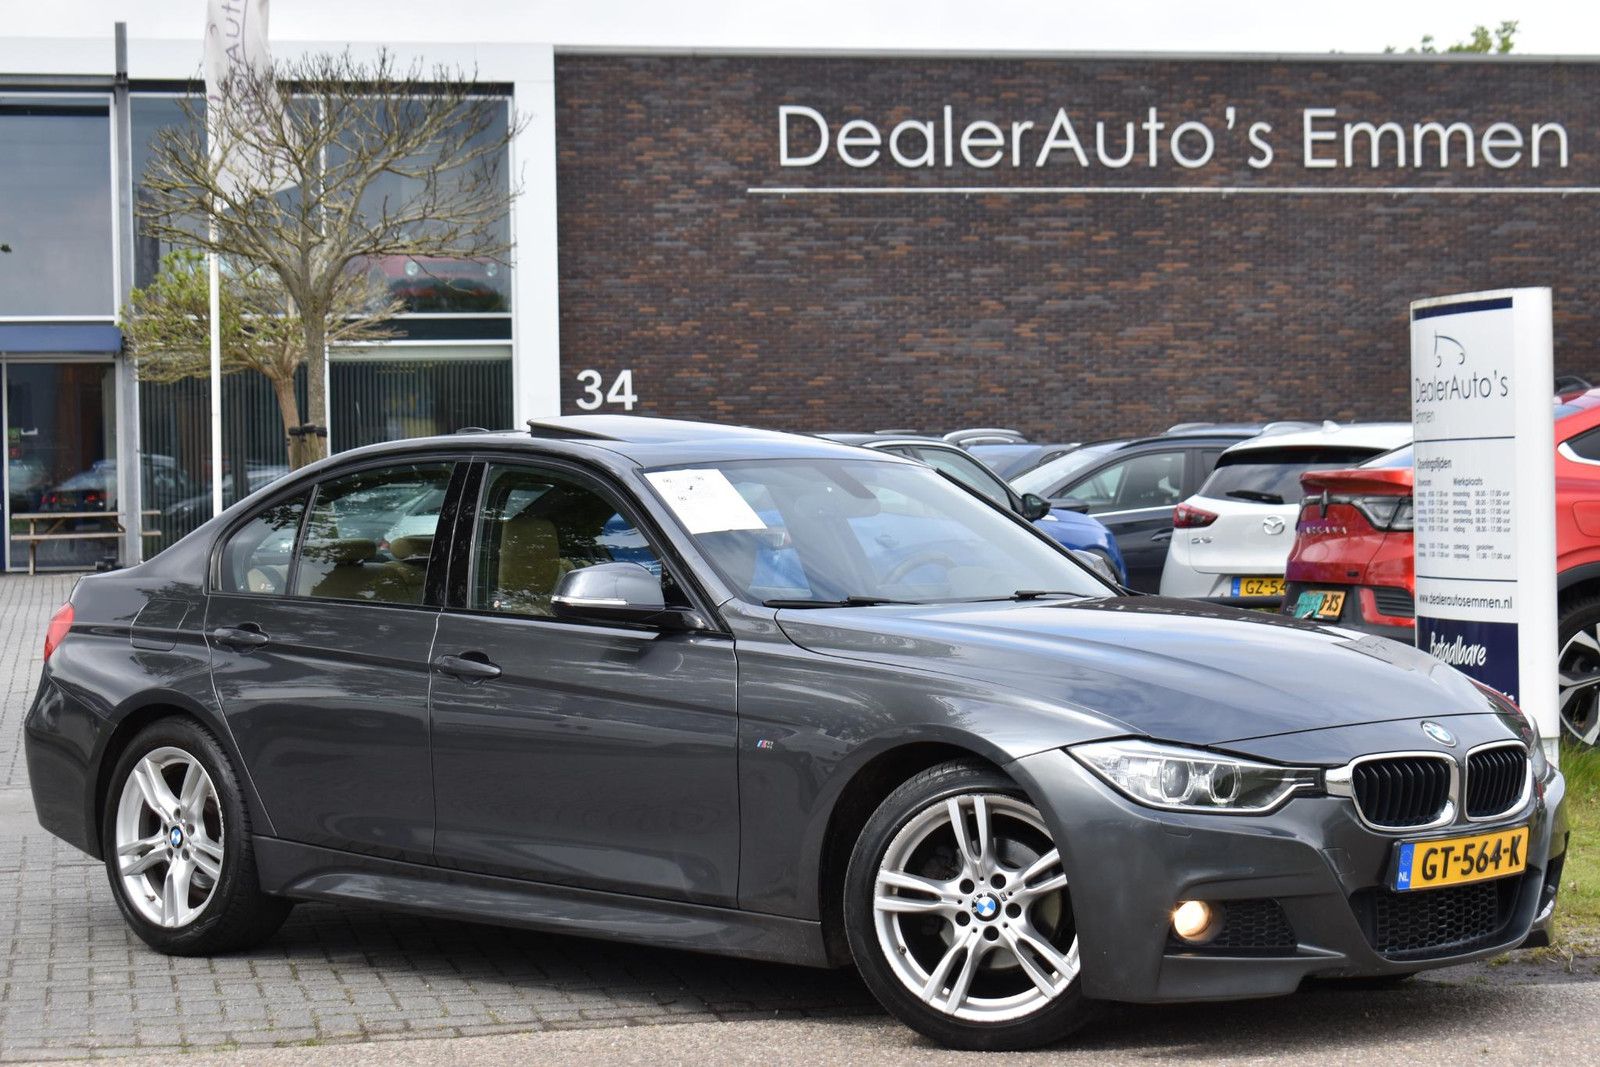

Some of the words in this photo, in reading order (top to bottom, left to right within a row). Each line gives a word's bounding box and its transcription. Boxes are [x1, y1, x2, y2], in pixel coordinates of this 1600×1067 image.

[777, 105, 1274, 168] DealerAuto's
[1303, 107, 1569, 168] Emmen
[576, 369, 638, 411] 34
[1398, 871, 1409, 882] NL
[1421, 834, 1522, 881] GT-564-K
